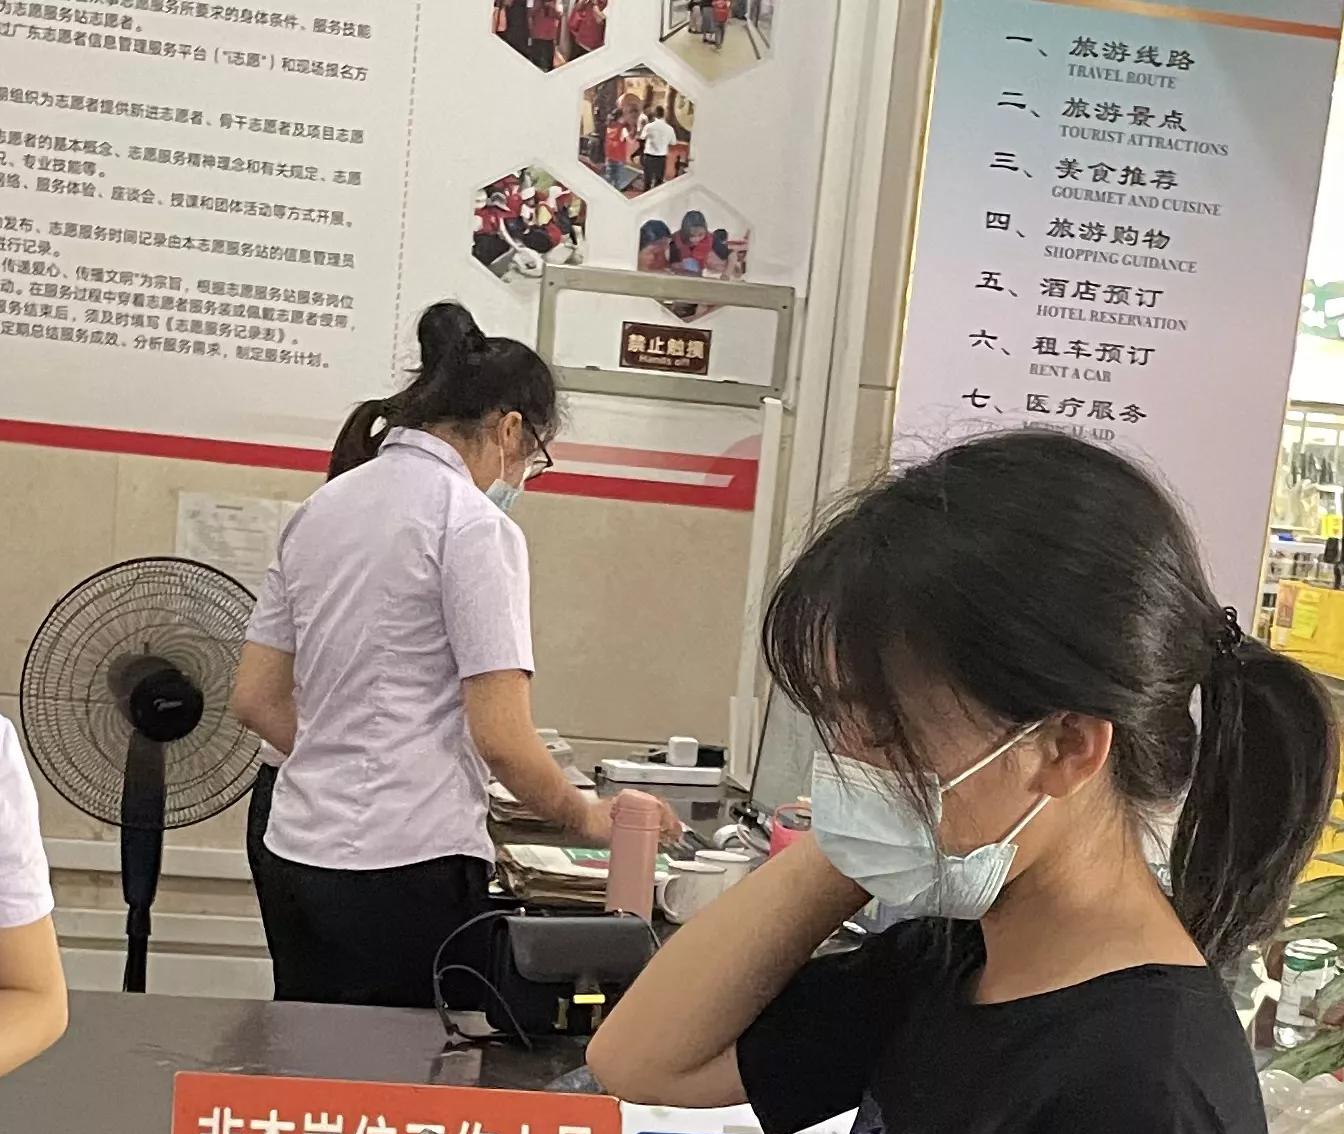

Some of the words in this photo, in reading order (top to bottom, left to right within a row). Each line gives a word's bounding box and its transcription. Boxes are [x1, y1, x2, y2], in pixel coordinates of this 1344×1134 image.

[1006, 35, 1195, 71] 一、旅游线路
[1068, 63, 1124, 83] TRAVEL
[1126, 72, 1177, 89] ROUTE
[997, 91, 1188, 132] 二、旅游景点
[1059, 124, 1125, 145] TOURIST
[1127, 134, 1229, 156] ATTRACTIONS
[989, 151, 1179, 190] 三、美食推荐
[1052, 185, 1127, 206] GOURMET
[1128, 193, 1160, 209] AND
[1161, 198, 1222, 216] CUISINE
[985, 211, 1171, 250] 四、旅游购物
[1044, 245, 1119, 266] SHOPPING
[1121, 254, 1198, 274] GUIDANCE
[975, 271, 1164, 308] 五、酒店预订
[1036, 304, 1087, 321] HOTEL
[1089, 310, 1188, 331] RESERVATION
[968, 329, 1156, 366] 六、租车预订
[1029, 363, 1069, 379] RENT
[1071, 367, 1081, 380] A
[1083, 368, 1112, 383] CAR
